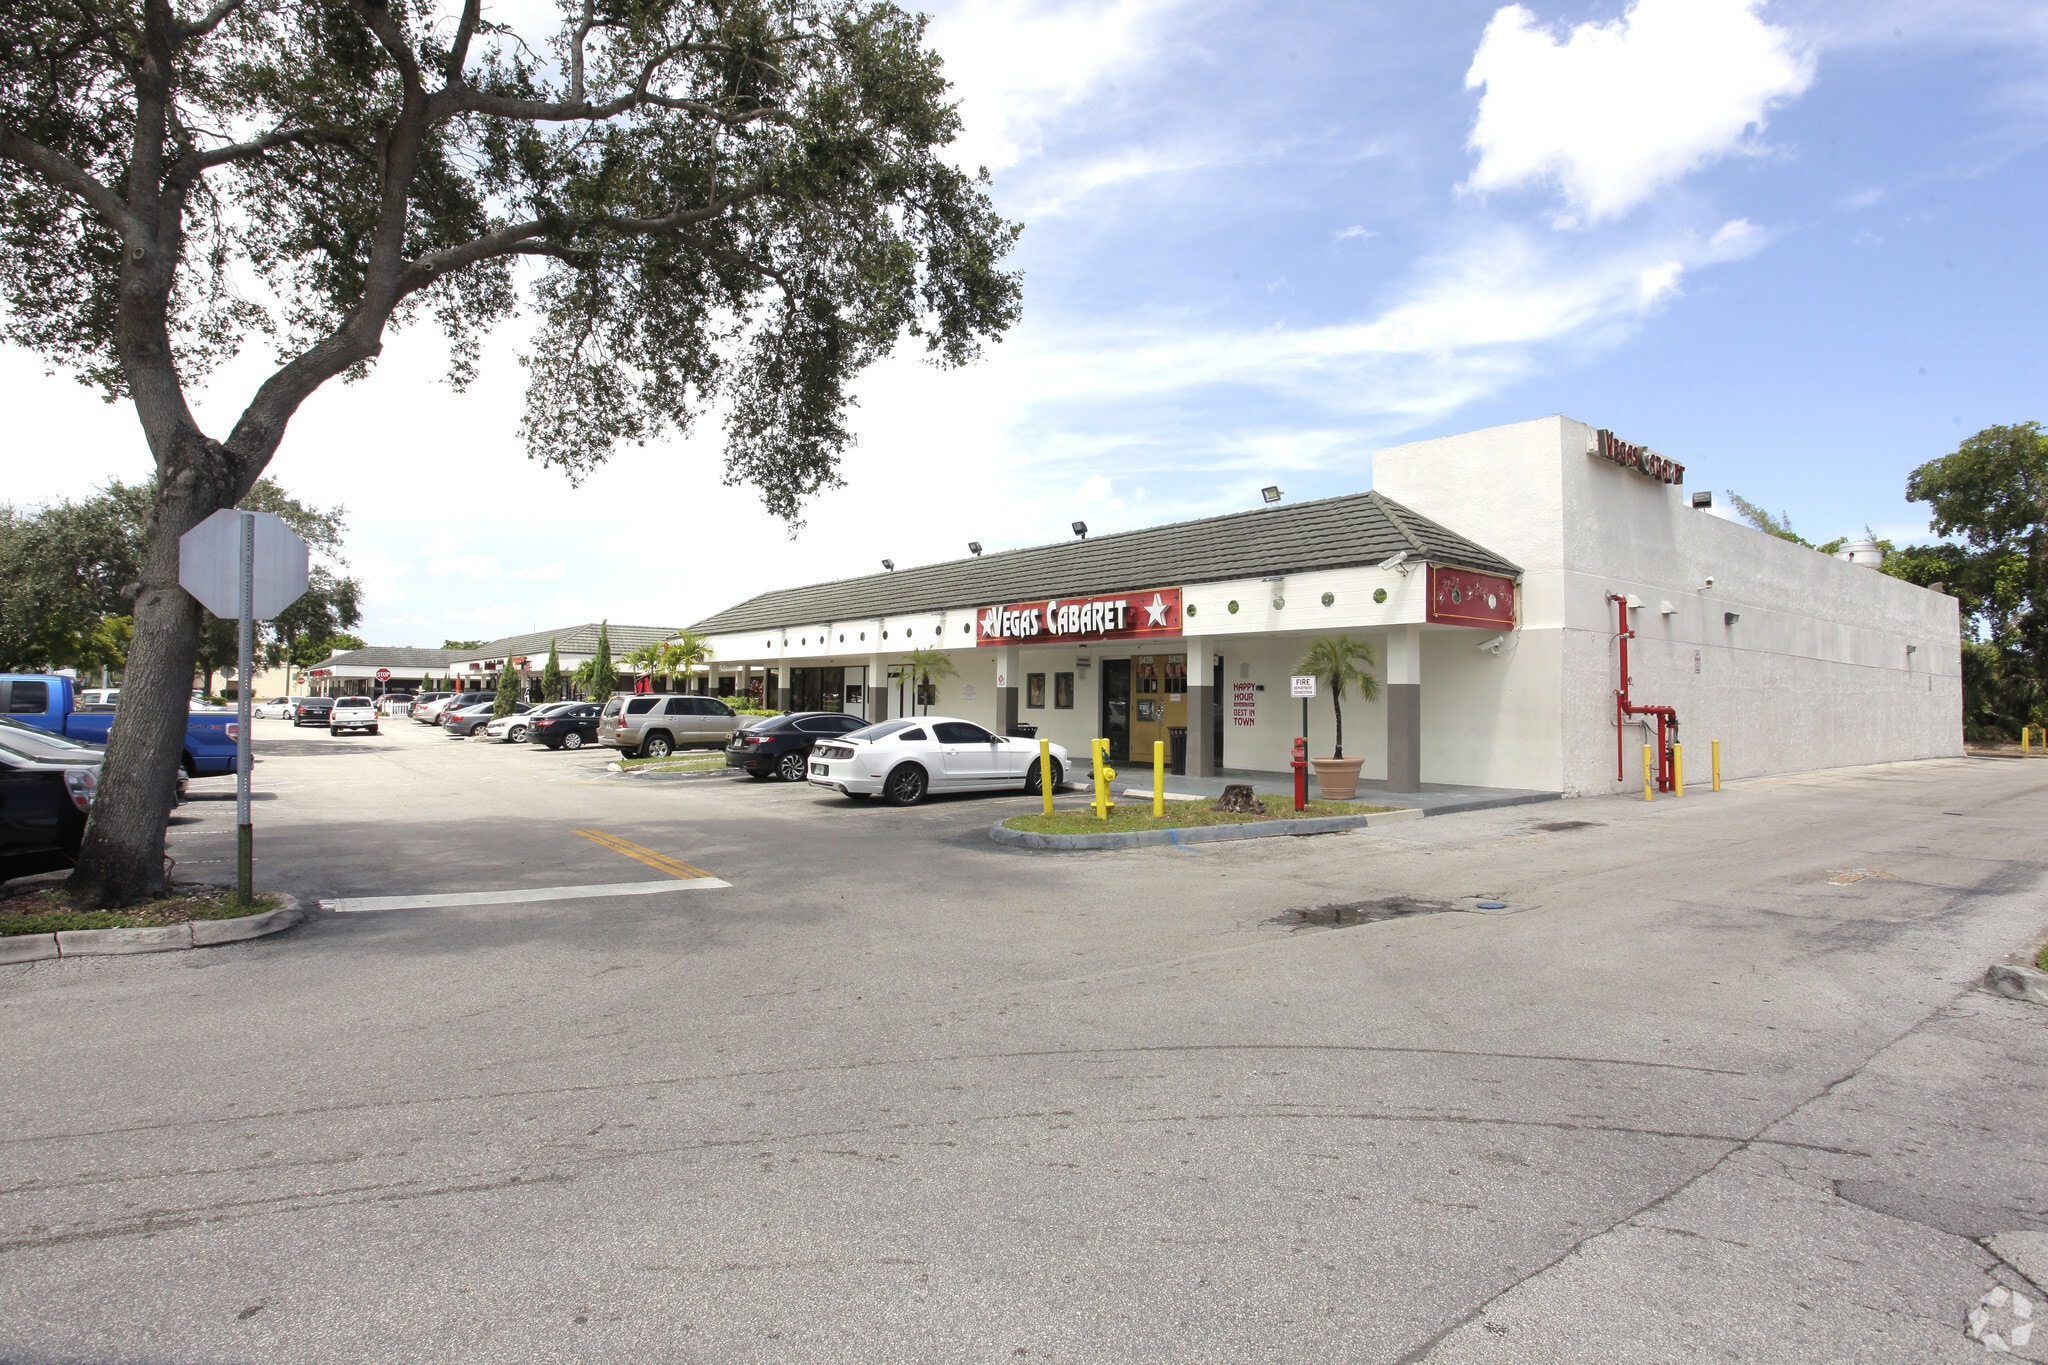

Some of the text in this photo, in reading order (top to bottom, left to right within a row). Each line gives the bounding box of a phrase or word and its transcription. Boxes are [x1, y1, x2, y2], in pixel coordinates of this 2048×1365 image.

[991, 600, 1127, 639] VEGAS CABARET
[1233, 683, 1256, 692] HAPPY
[1234, 693, 1254, 701] HOUR
[1249, 709, 1255, 717] IN
[1233, 718, 1255, 727] TOWN
